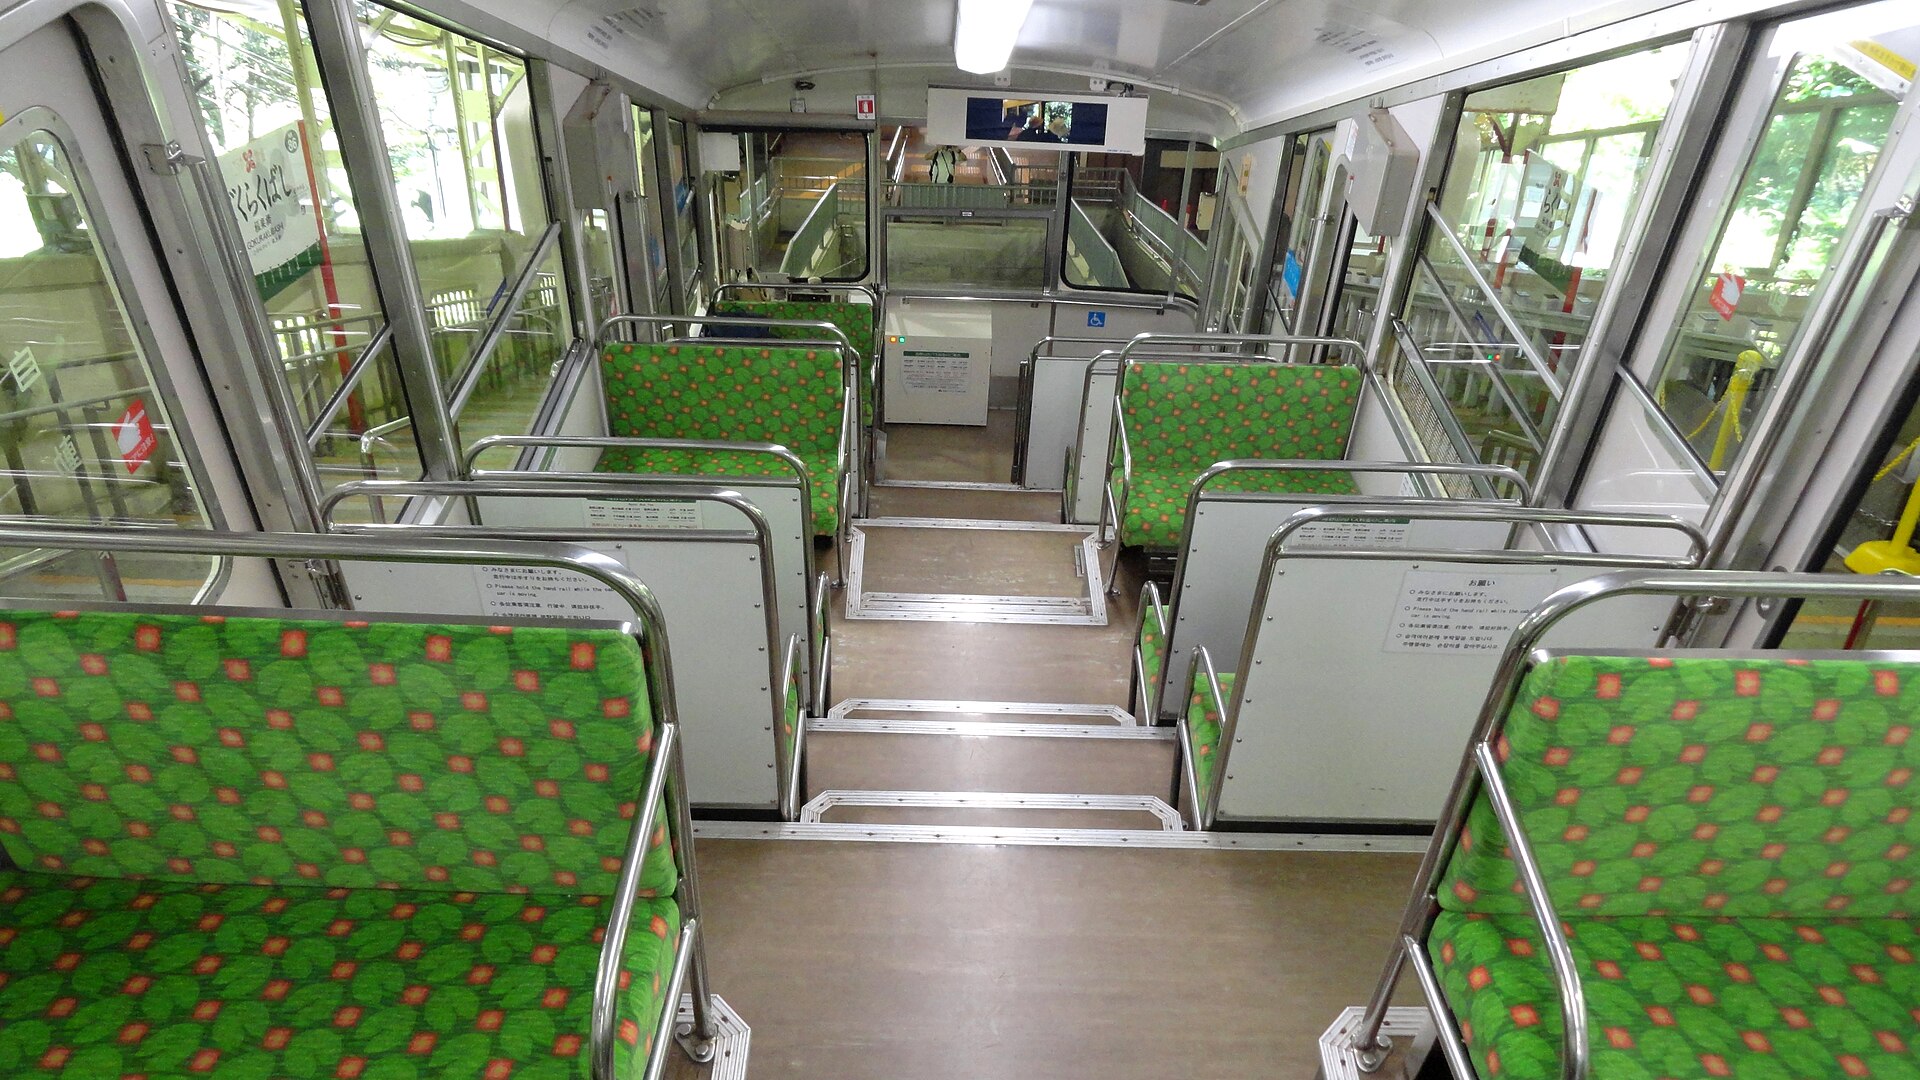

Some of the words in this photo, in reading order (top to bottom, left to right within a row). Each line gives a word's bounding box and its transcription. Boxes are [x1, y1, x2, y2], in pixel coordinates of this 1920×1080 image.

[229, 164, 292, 222] くらくばし
[1468, 579, 1496, 587] お願い
